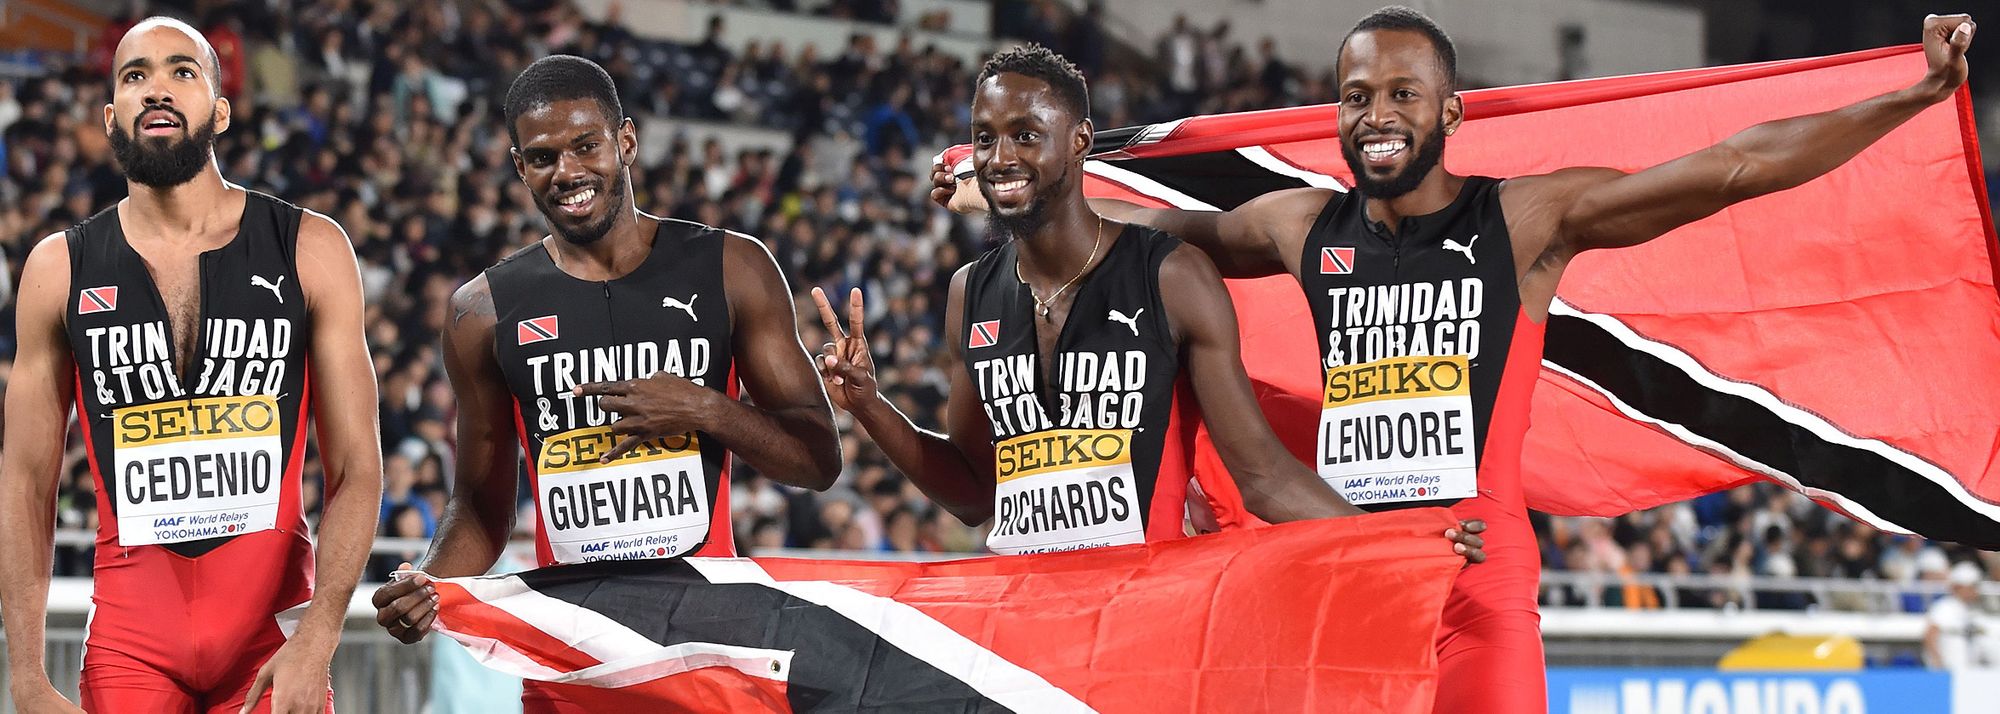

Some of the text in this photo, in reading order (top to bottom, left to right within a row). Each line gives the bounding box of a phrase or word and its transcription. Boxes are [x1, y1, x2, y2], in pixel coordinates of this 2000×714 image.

[1328, 277, 1484, 328] TRINIDAD
[527, 338, 710, 396] TRINIDAD
[1328, 360, 1462, 403] SEIKO
[121, 400, 274, 443] SEIKO
[1324, 410, 1464, 465] LENDORE
[125, 449, 271, 504] CEDENIO
[999, 433, 1124, 477] SEIKO
[548, 470, 700, 531] GUEVARA
[1344, 474, 1440, 489] IAAF World Relays
[1345, 488, 1407, 502] YOKOHAMA
[153, 511, 249, 528] IAAF World Relays
[994, 476, 1130, 537] RICHARDS
[154, 526, 218, 540] YOKOHAMA
[581, 534, 678, 553] IAAF World Relays
